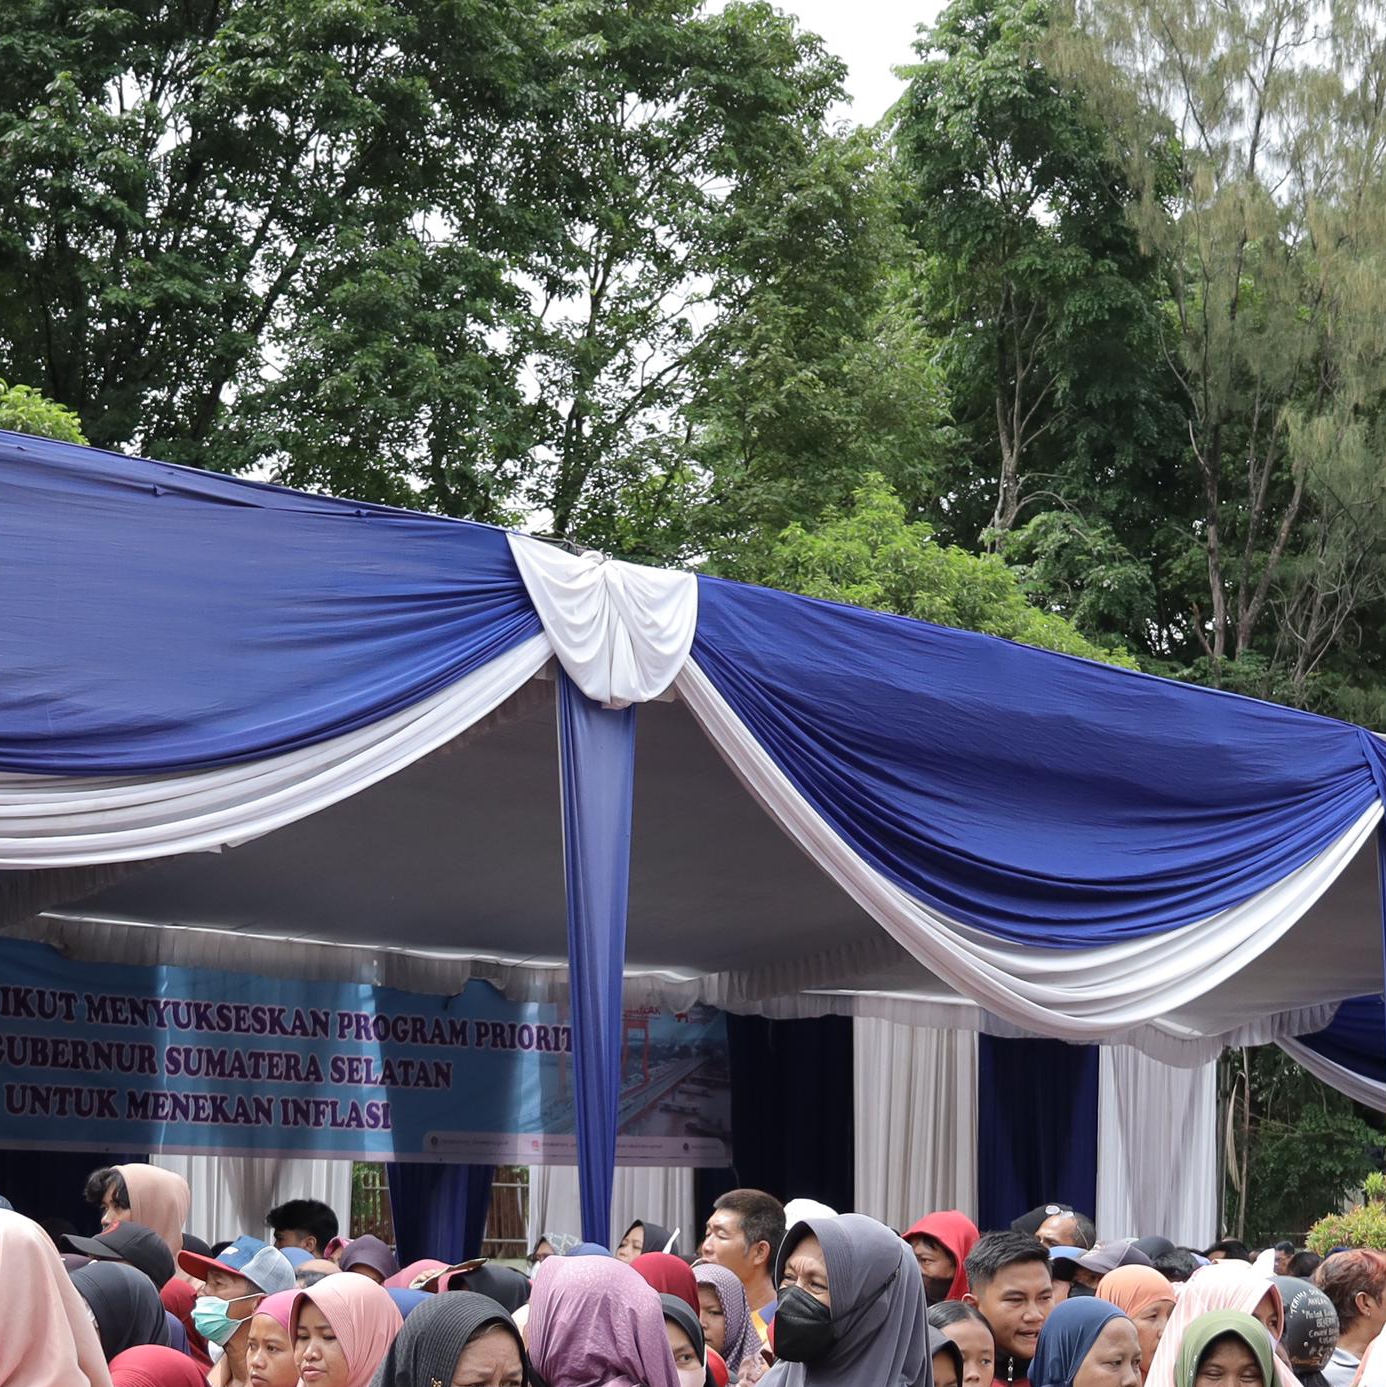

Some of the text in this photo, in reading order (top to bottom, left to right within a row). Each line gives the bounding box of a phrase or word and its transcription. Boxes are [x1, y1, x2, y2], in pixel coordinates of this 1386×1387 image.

[0, 985, 78, 1022] IKUT
[85, 996, 331, 1040] MENYUKSESKAN
[336, 1012, 468, 1048] PROGRAM
[165, 1046, 323, 1084] SUMATERA
[330, 1054, 452, 1090] SELATAN
[4, 1083, 392, 1131] UNTUK MENEKAN INFLASI
